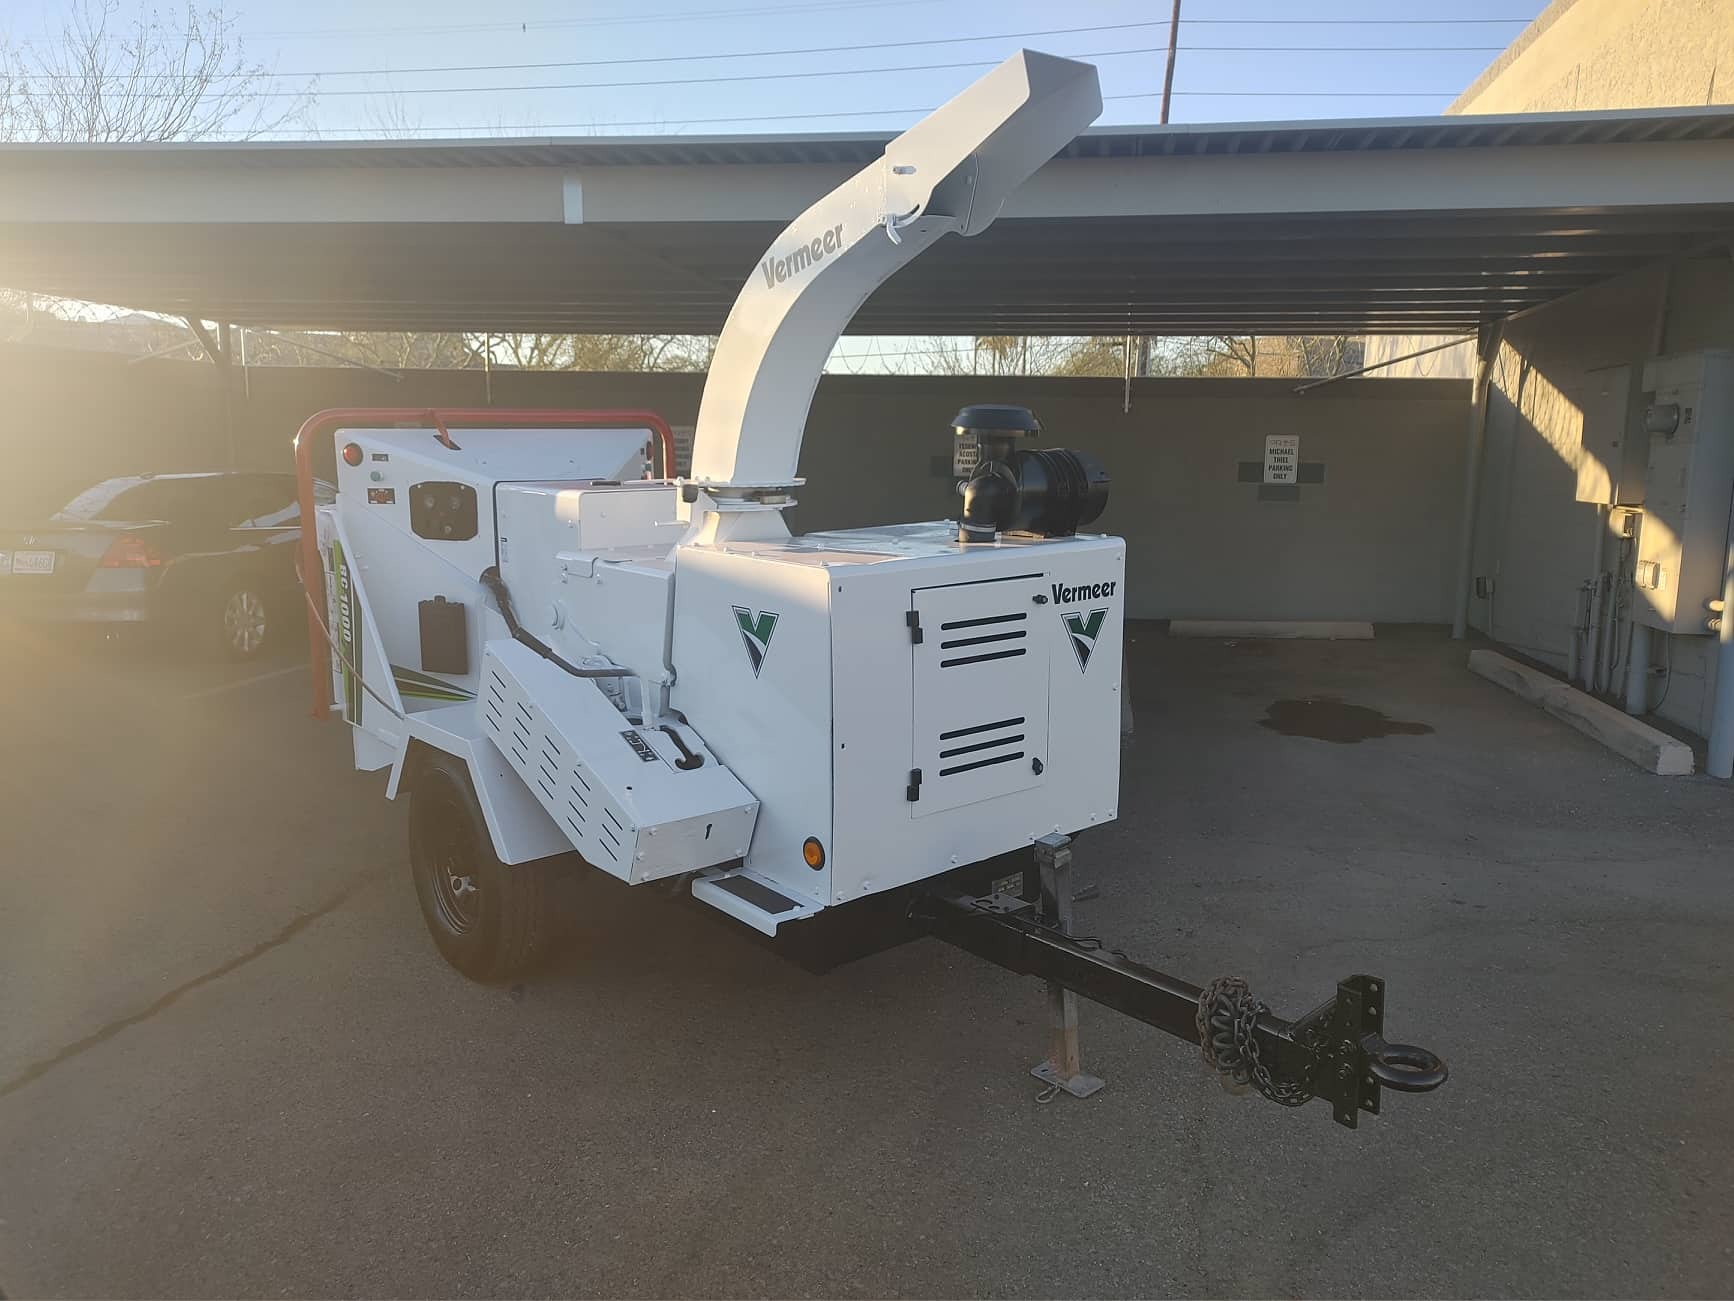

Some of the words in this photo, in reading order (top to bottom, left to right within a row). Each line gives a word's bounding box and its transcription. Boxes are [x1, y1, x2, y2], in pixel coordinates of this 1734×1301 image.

[761, 223, 843, 290] Vermeer
[1268, 464, 1294, 472] PARKING
[1051, 581, 1117, 605] Vermeer
